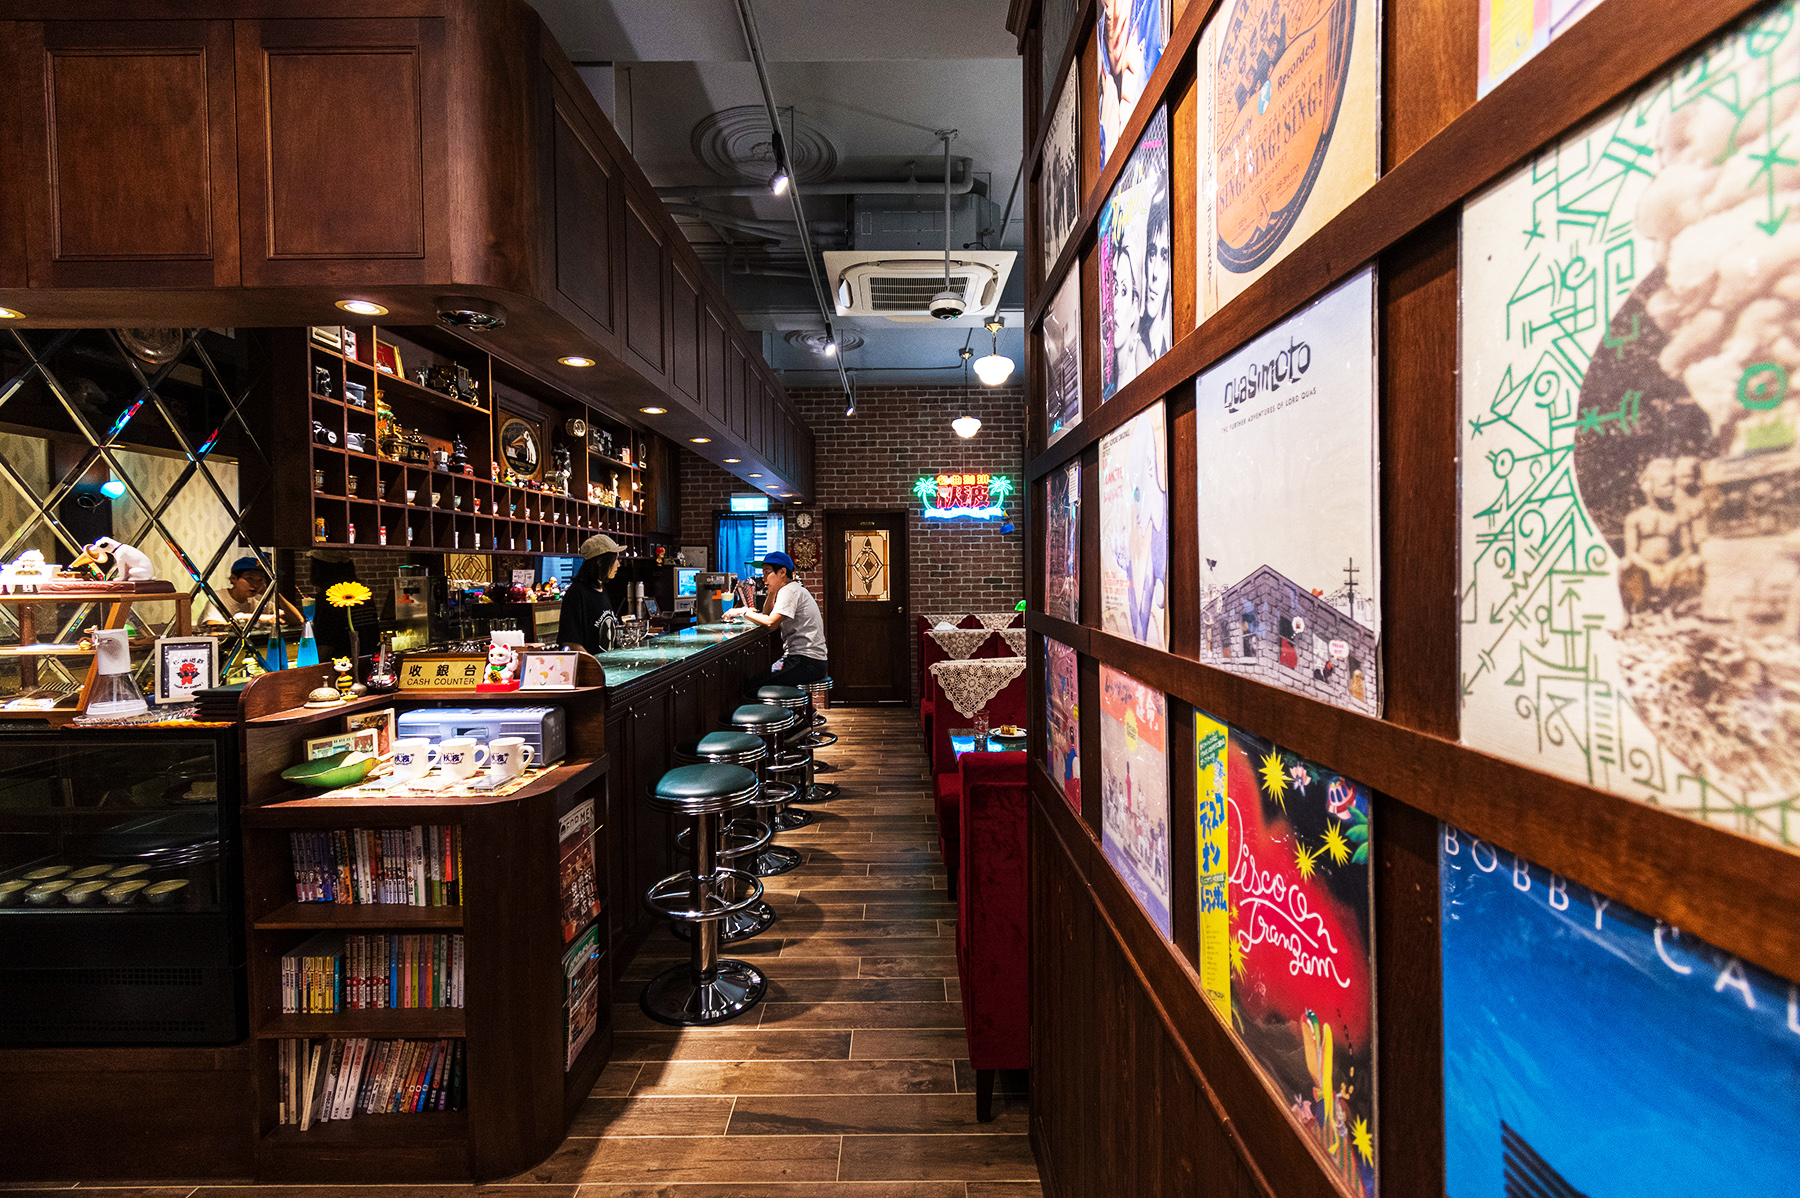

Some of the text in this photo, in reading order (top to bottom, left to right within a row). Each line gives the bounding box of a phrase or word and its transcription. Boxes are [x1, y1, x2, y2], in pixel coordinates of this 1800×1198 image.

[1277, 33, 1317, 91] Recorded
[1219, 162, 1246, 215] SING!
[1284, 74, 1322, 144] SING!
[1229, 417, 1247, 432] FURTHER
[1248, 405, 1276, 424] ADVENTURES
[1277, 401, 1285, 410] OF
[1285, 395, 1300, 407] LORD
[1301, 387, 1317, 400] QUAS
[406, 677, 475, 686] CASH COUNTER
[408, 664, 477, 677] 收銀台
[1227, 797, 1287, 902] Disco
[1445, 824, 1611, 930] BOBBY
[1237, 897, 1351, 988] Tranzam
